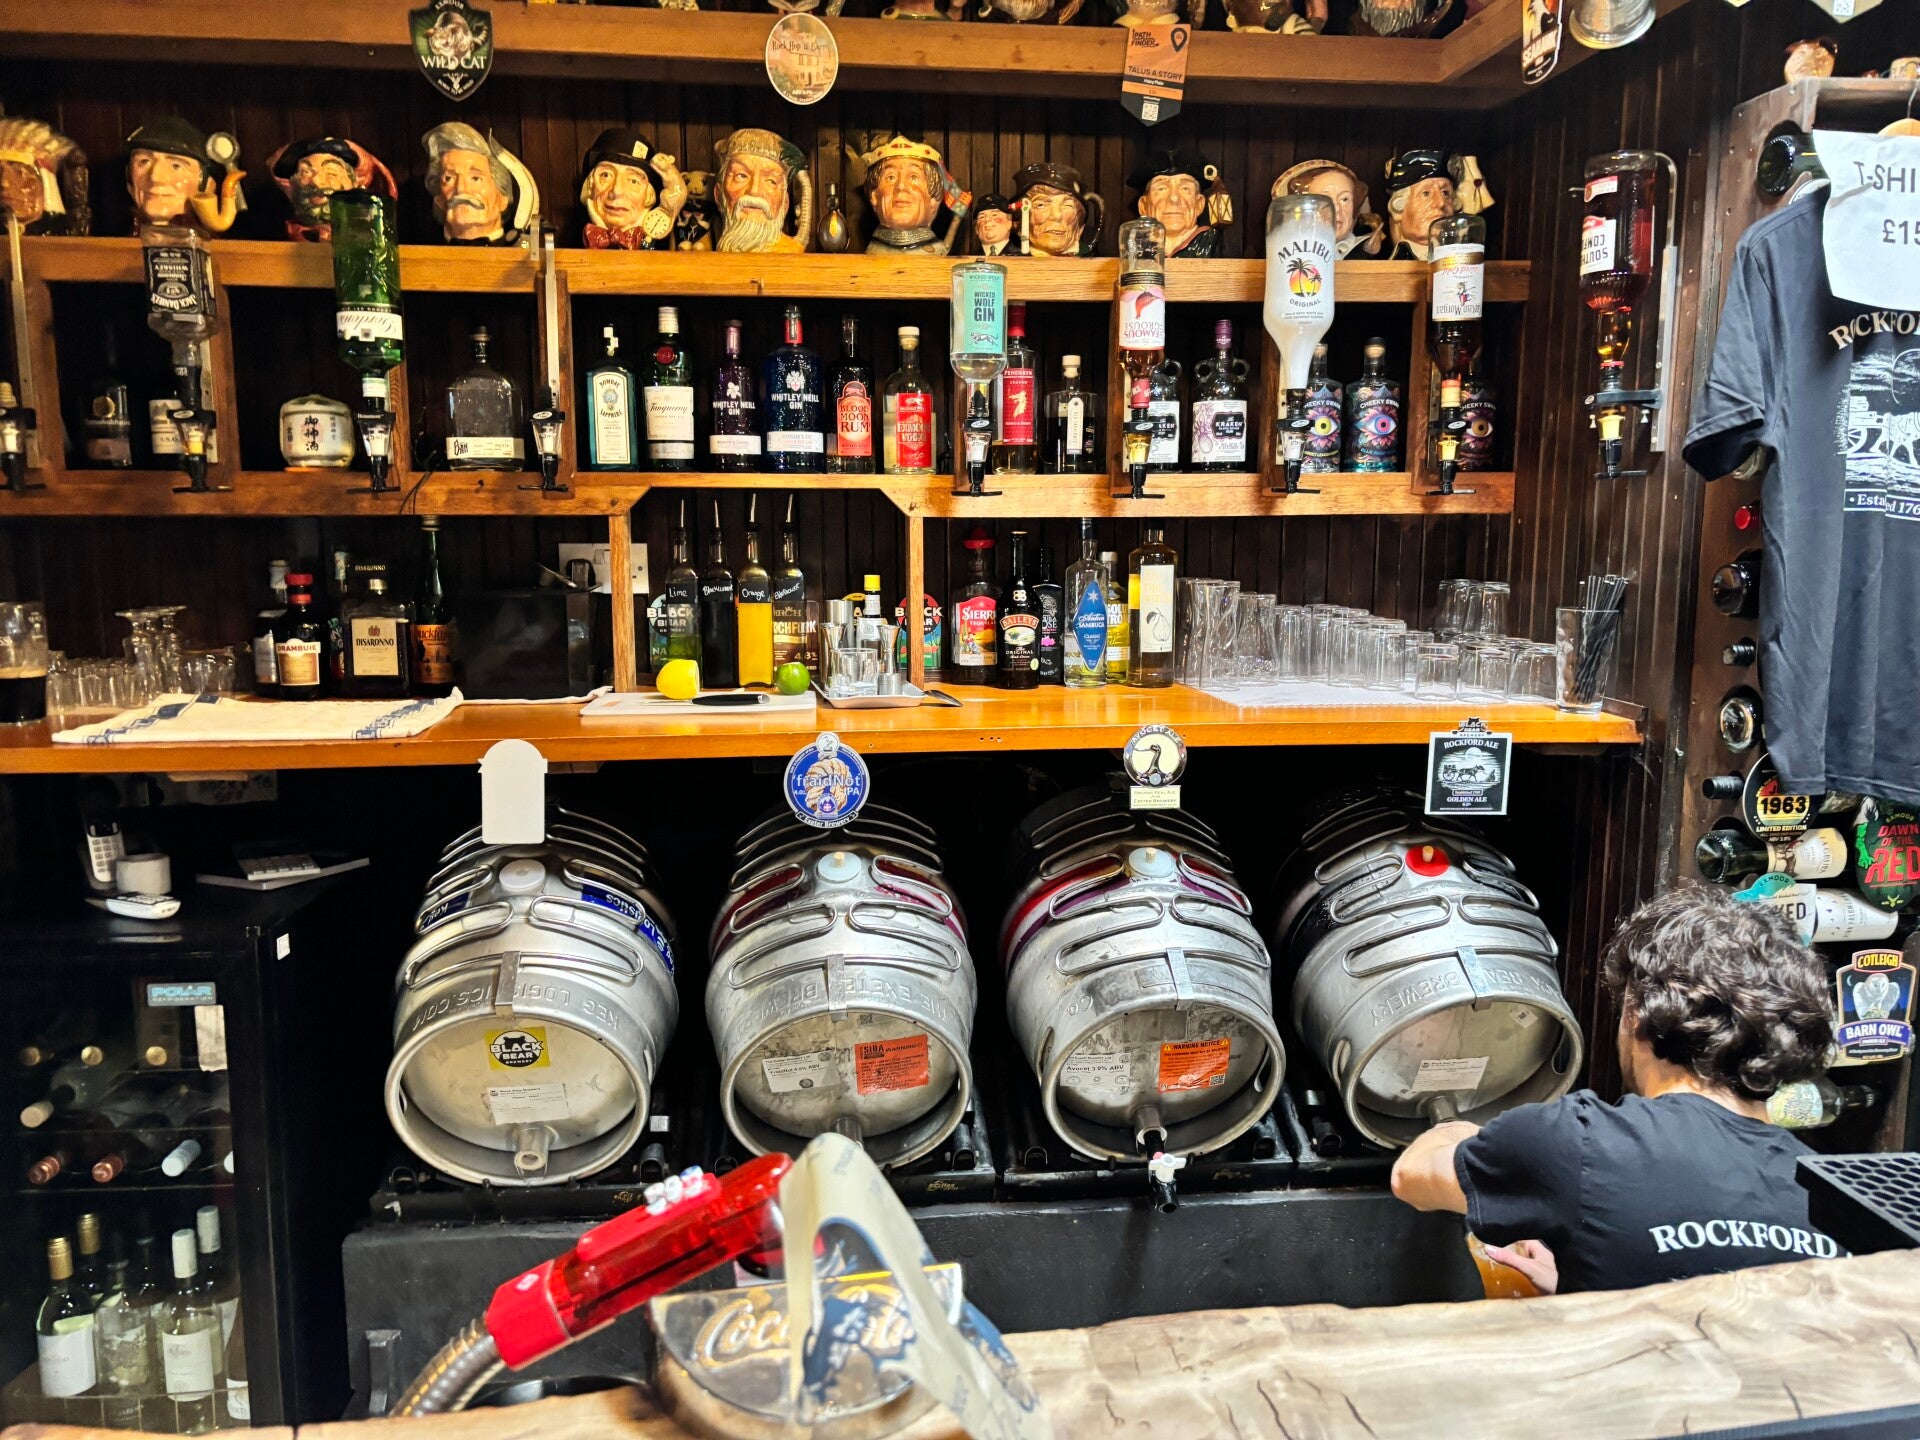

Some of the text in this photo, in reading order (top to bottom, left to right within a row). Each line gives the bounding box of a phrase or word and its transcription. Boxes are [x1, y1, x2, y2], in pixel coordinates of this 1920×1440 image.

[422, 56, 487, 70] WILD CAT
[1128, 66, 1151, 76] TALUS
[1158, 71, 1183, 81] STORY
[1278, 240, 1334, 264] MALIBU
[180, 294, 197, 308] JACK
[974, 298, 996, 307] WOLF
[1290, 298, 1321, 308] ORIGINAL
[974, 307, 995, 322] GIN
[1124, 330, 1160, 339] FAMOUS
[771, 394, 820, 403] WHITLEY NEILL
[1360, 399, 1385, 409] CHEEKY
[650, 402, 688, 414] Tanqueray
[790, 402, 803, 410] GIN
[840, 405, 869, 413] BLOOD
[1304, 401, 1325, 409] HEEKY
[728, 408, 740, 416] GIN
[840, 413, 869, 421] MOON
[841, 422, 870, 433] RUM
[669, 587, 688, 598] Lime
[742, 588, 765, 600] Orange
[647, 608, 695, 618] BLACK
[895, 607, 943, 617] BCK
[1003, 616, 1038, 629] BAILEYS
[278, 644, 318, 652] DRAMBUIE
[1444, 739, 1499, 750] ROCKFORD ALE
[844, 787, 860, 796] IPA
[1761, 796, 1807, 815] 1963
[1886, 812, 1915, 823] EXMOOR
[1878, 824, 1919, 837] DAWN
[1881, 837, 1893, 847] OF
[1864, 846, 1920, 884] RED
[1760, 875, 1790, 887] EXMOOR
[1858, 953, 1899, 968] COTLEIGH
[152, 986, 212, 997] POLAR
[1370, 968, 1524, 1026] BEA BREWERY
[412, 984, 619, 1032] KEG LOGIICS.COM
[1846, 1024, 1903, 1040] BARN OWL
[490, 1041, 544, 1053] BLACK
[864, 1045, 885, 1054] SIBA
[1200, 1040, 1221, 1048] NOTICE
[502, 1052, 535, 1060] BEAR
[1649, 1220, 1839, 1259] ROCKFORD
